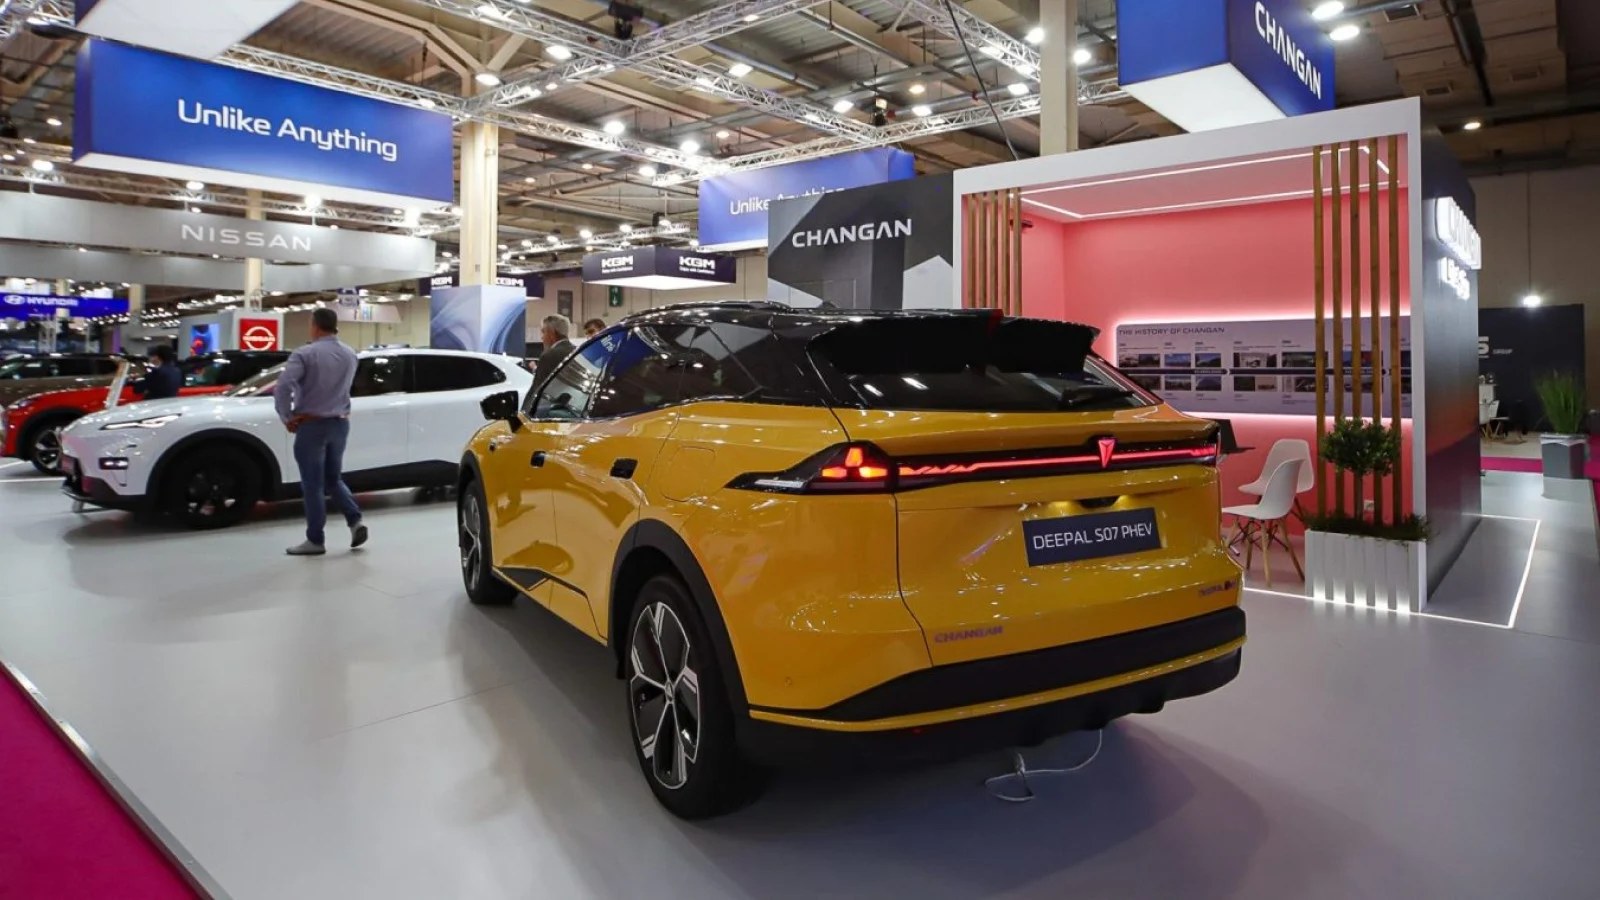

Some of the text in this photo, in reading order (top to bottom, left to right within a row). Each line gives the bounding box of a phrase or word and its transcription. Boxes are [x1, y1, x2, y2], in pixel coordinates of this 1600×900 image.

[1255, 1, 1321, 100] CHANGAN
[178, 98, 398, 162] Unlike Anything
[730, 198, 769, 215] Unlike
[181, 223, 312, 252] NISSAN
[792, 218, 912, 248] CHANGAN
[601, 255, 634, 268] KGM
[679, 256, 716, 270] KGM
[1032, 522, 1152, 550] DEEPAL S07 PHEV
